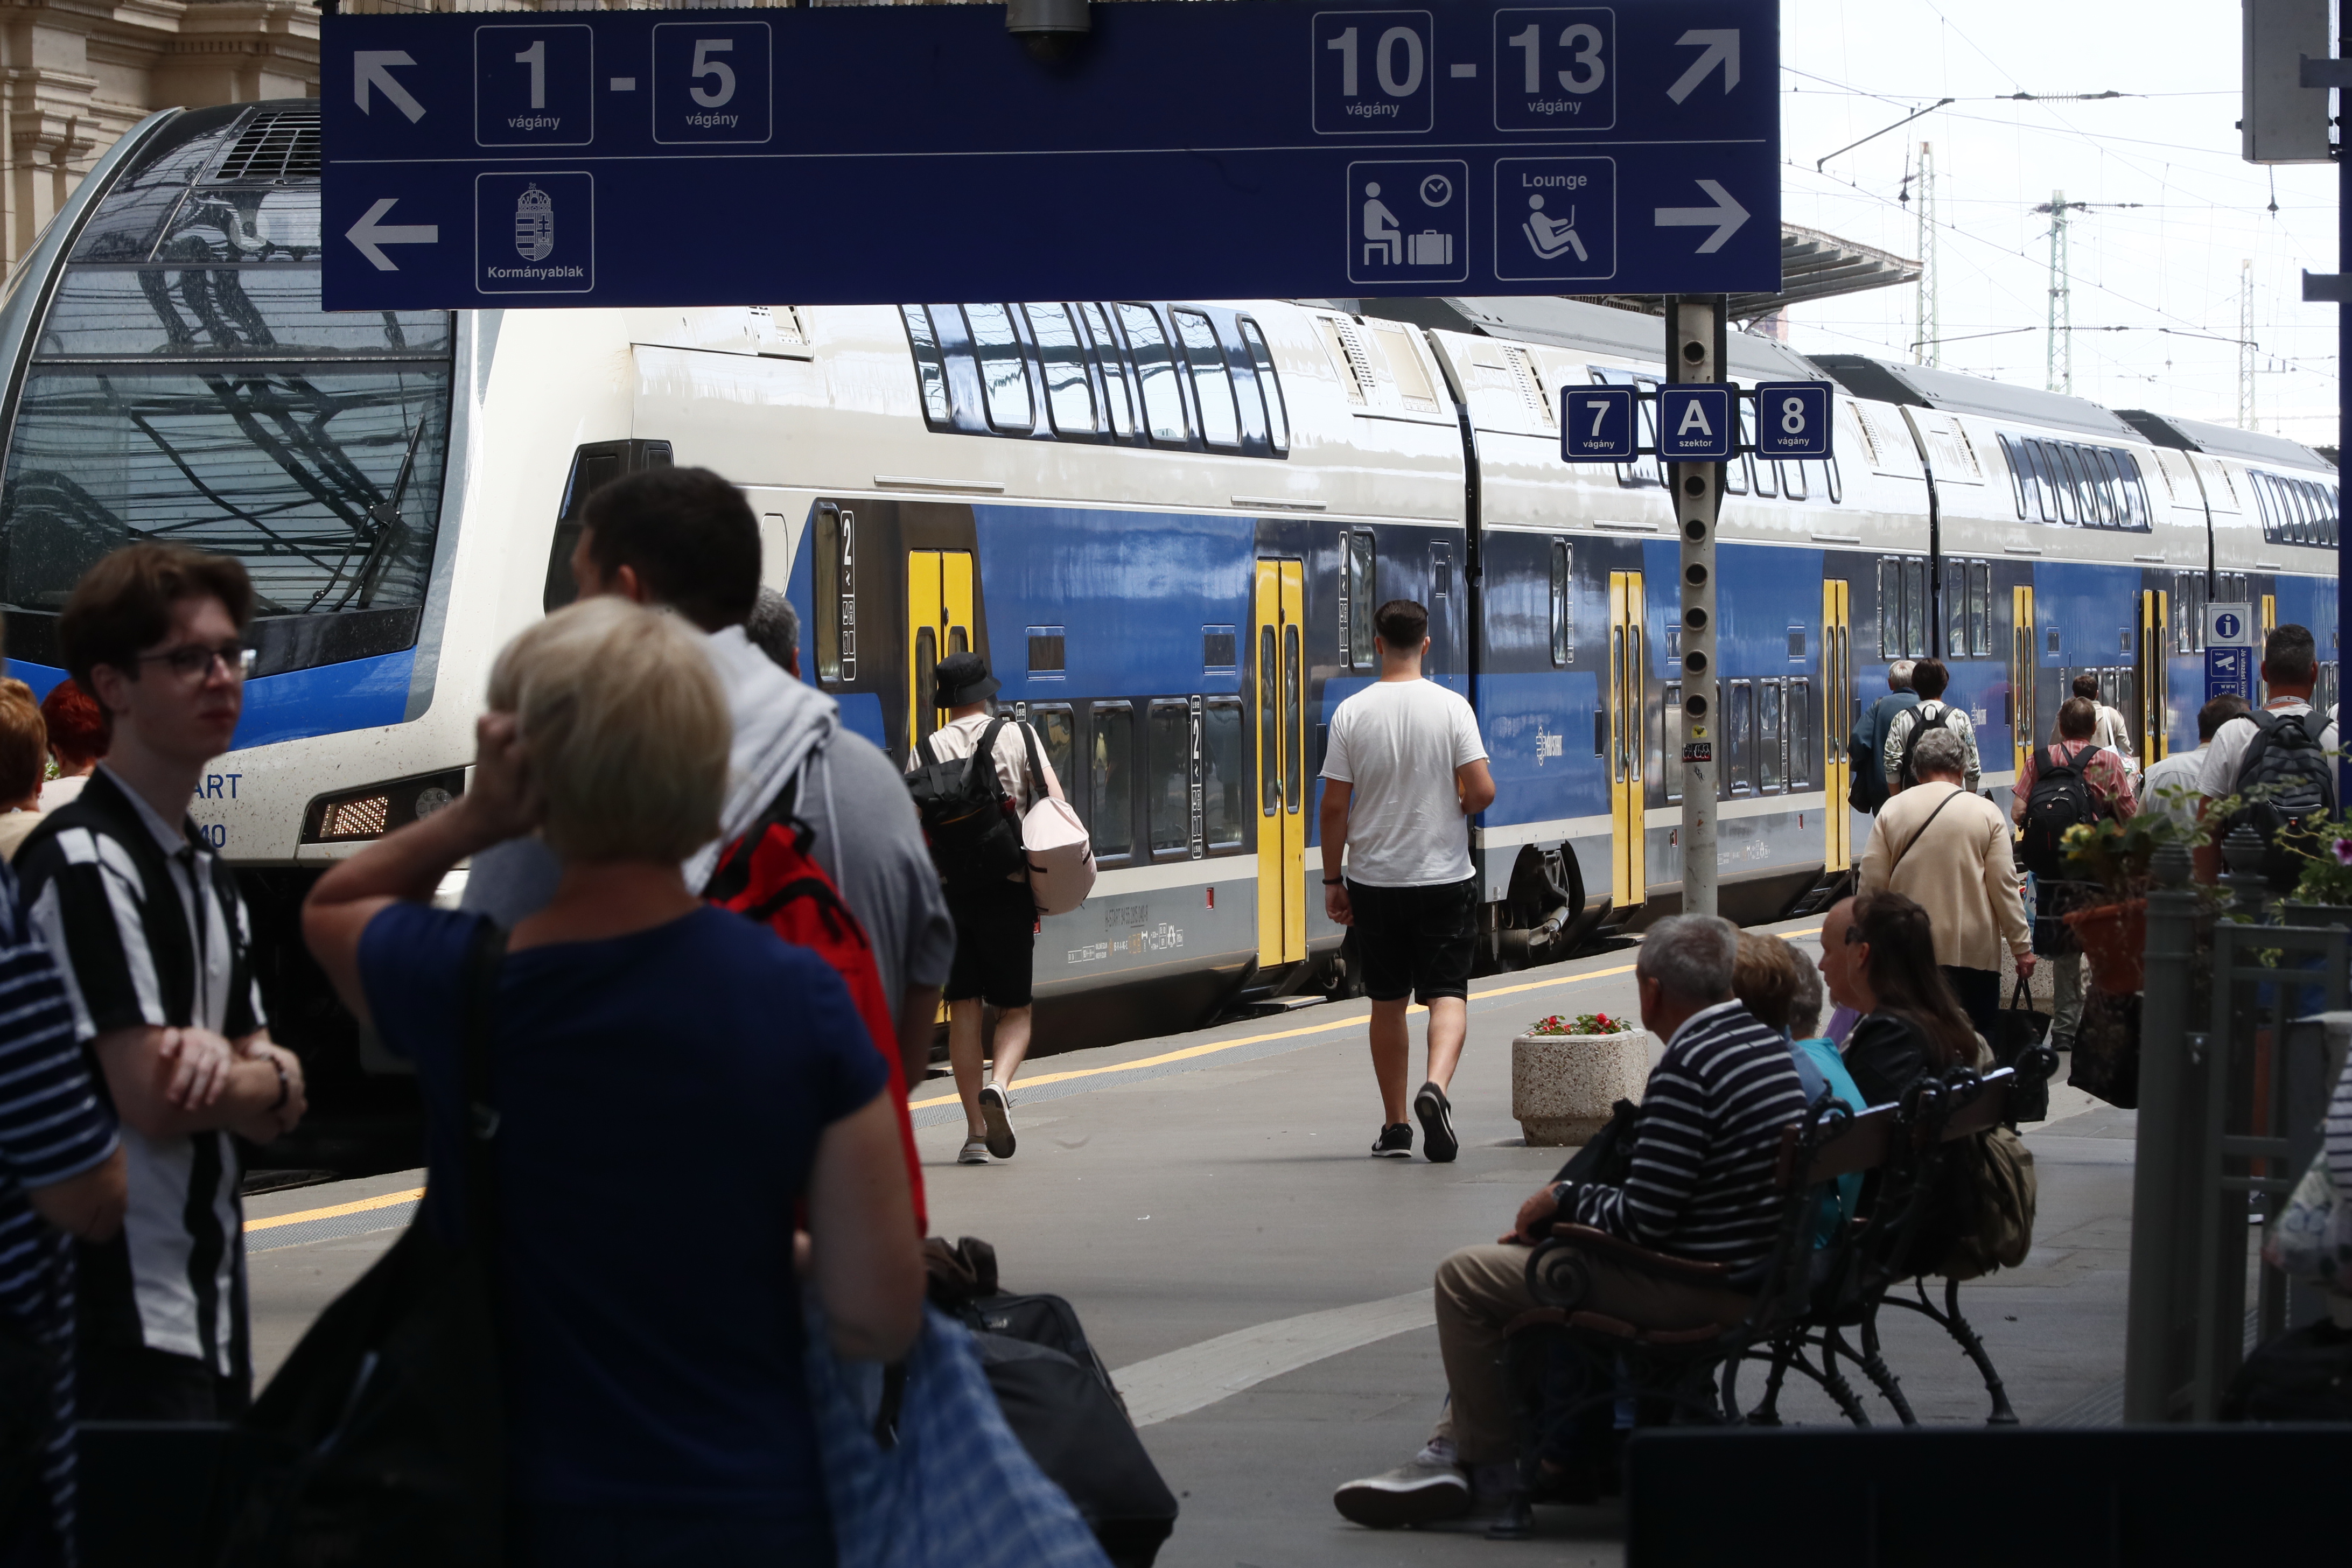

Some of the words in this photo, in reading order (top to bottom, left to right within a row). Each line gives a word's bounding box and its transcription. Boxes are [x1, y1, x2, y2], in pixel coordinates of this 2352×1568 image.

[1327, 26, 1424, 97] 10
[1509, 23, 1605, 94] 13
[515, 40, 545, 109] 1
[689, 39, 736, 108] 5
[685, 112, 739, 128] vágány
[1346, 101, 1399, 118] vágány
[1528, 99, 1582, 115] vágány
[508, 115, 561, 130] vágány
[1522, 173, 1587, 190] Lounge
[488, 265, 584, 281] Kormányablak
[1587, 401, 1610, 437] 7
[1677, 400, 1713, 436] A
[1782, 397, 1805, 434] 8
[1583, 439, 1615, 450] vágány
[1679, 439, 1713, 447] szektor
[1777, 437, 1810, 447] vágány
[843, 518, 852, 565] 2
[1341, 537, 1346, 575] 2
[1567, 548, 1572, 582] 2
[1878, 564, 1881, 591] 2
[1986, 567, 1990, 593] 2
[1782, 693, 1786, 723] 2
[1193, 719, 1199, 759] 2
